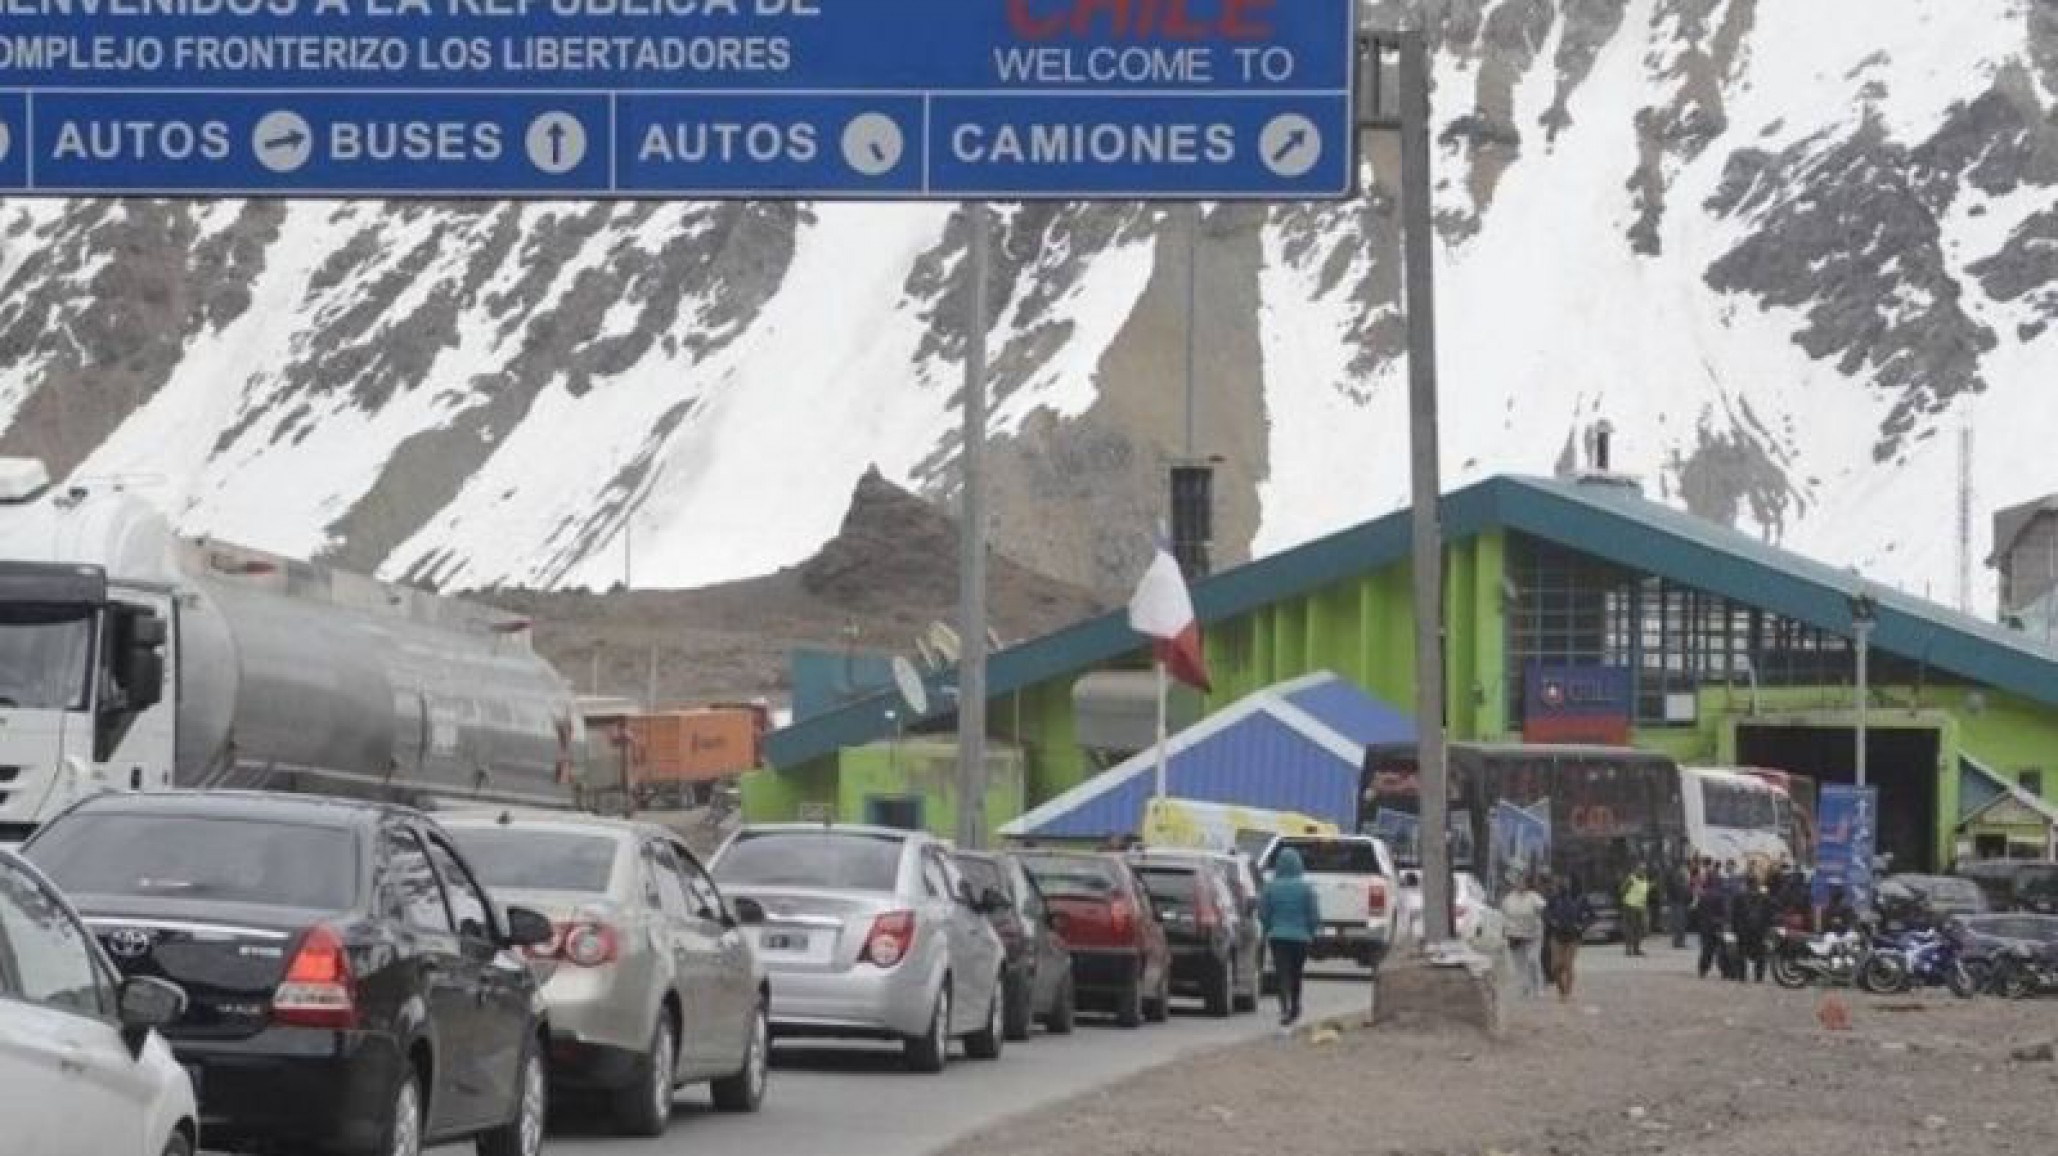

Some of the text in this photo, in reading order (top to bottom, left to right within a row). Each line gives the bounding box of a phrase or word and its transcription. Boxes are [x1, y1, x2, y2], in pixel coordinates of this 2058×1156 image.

[174, 35, 408, 70] FRONTERIZO
[419, 35, 492, 70] LOS
[503, 35, 792, 70] LIBERTADORES
[994, 47, 1294, 82] WELCOME TO
[51, 120, 503, 160] AUTOS BUSES
[637, 122, 818, 162] AUTOS
[952, 122, 1236, 163] CAMIONES
